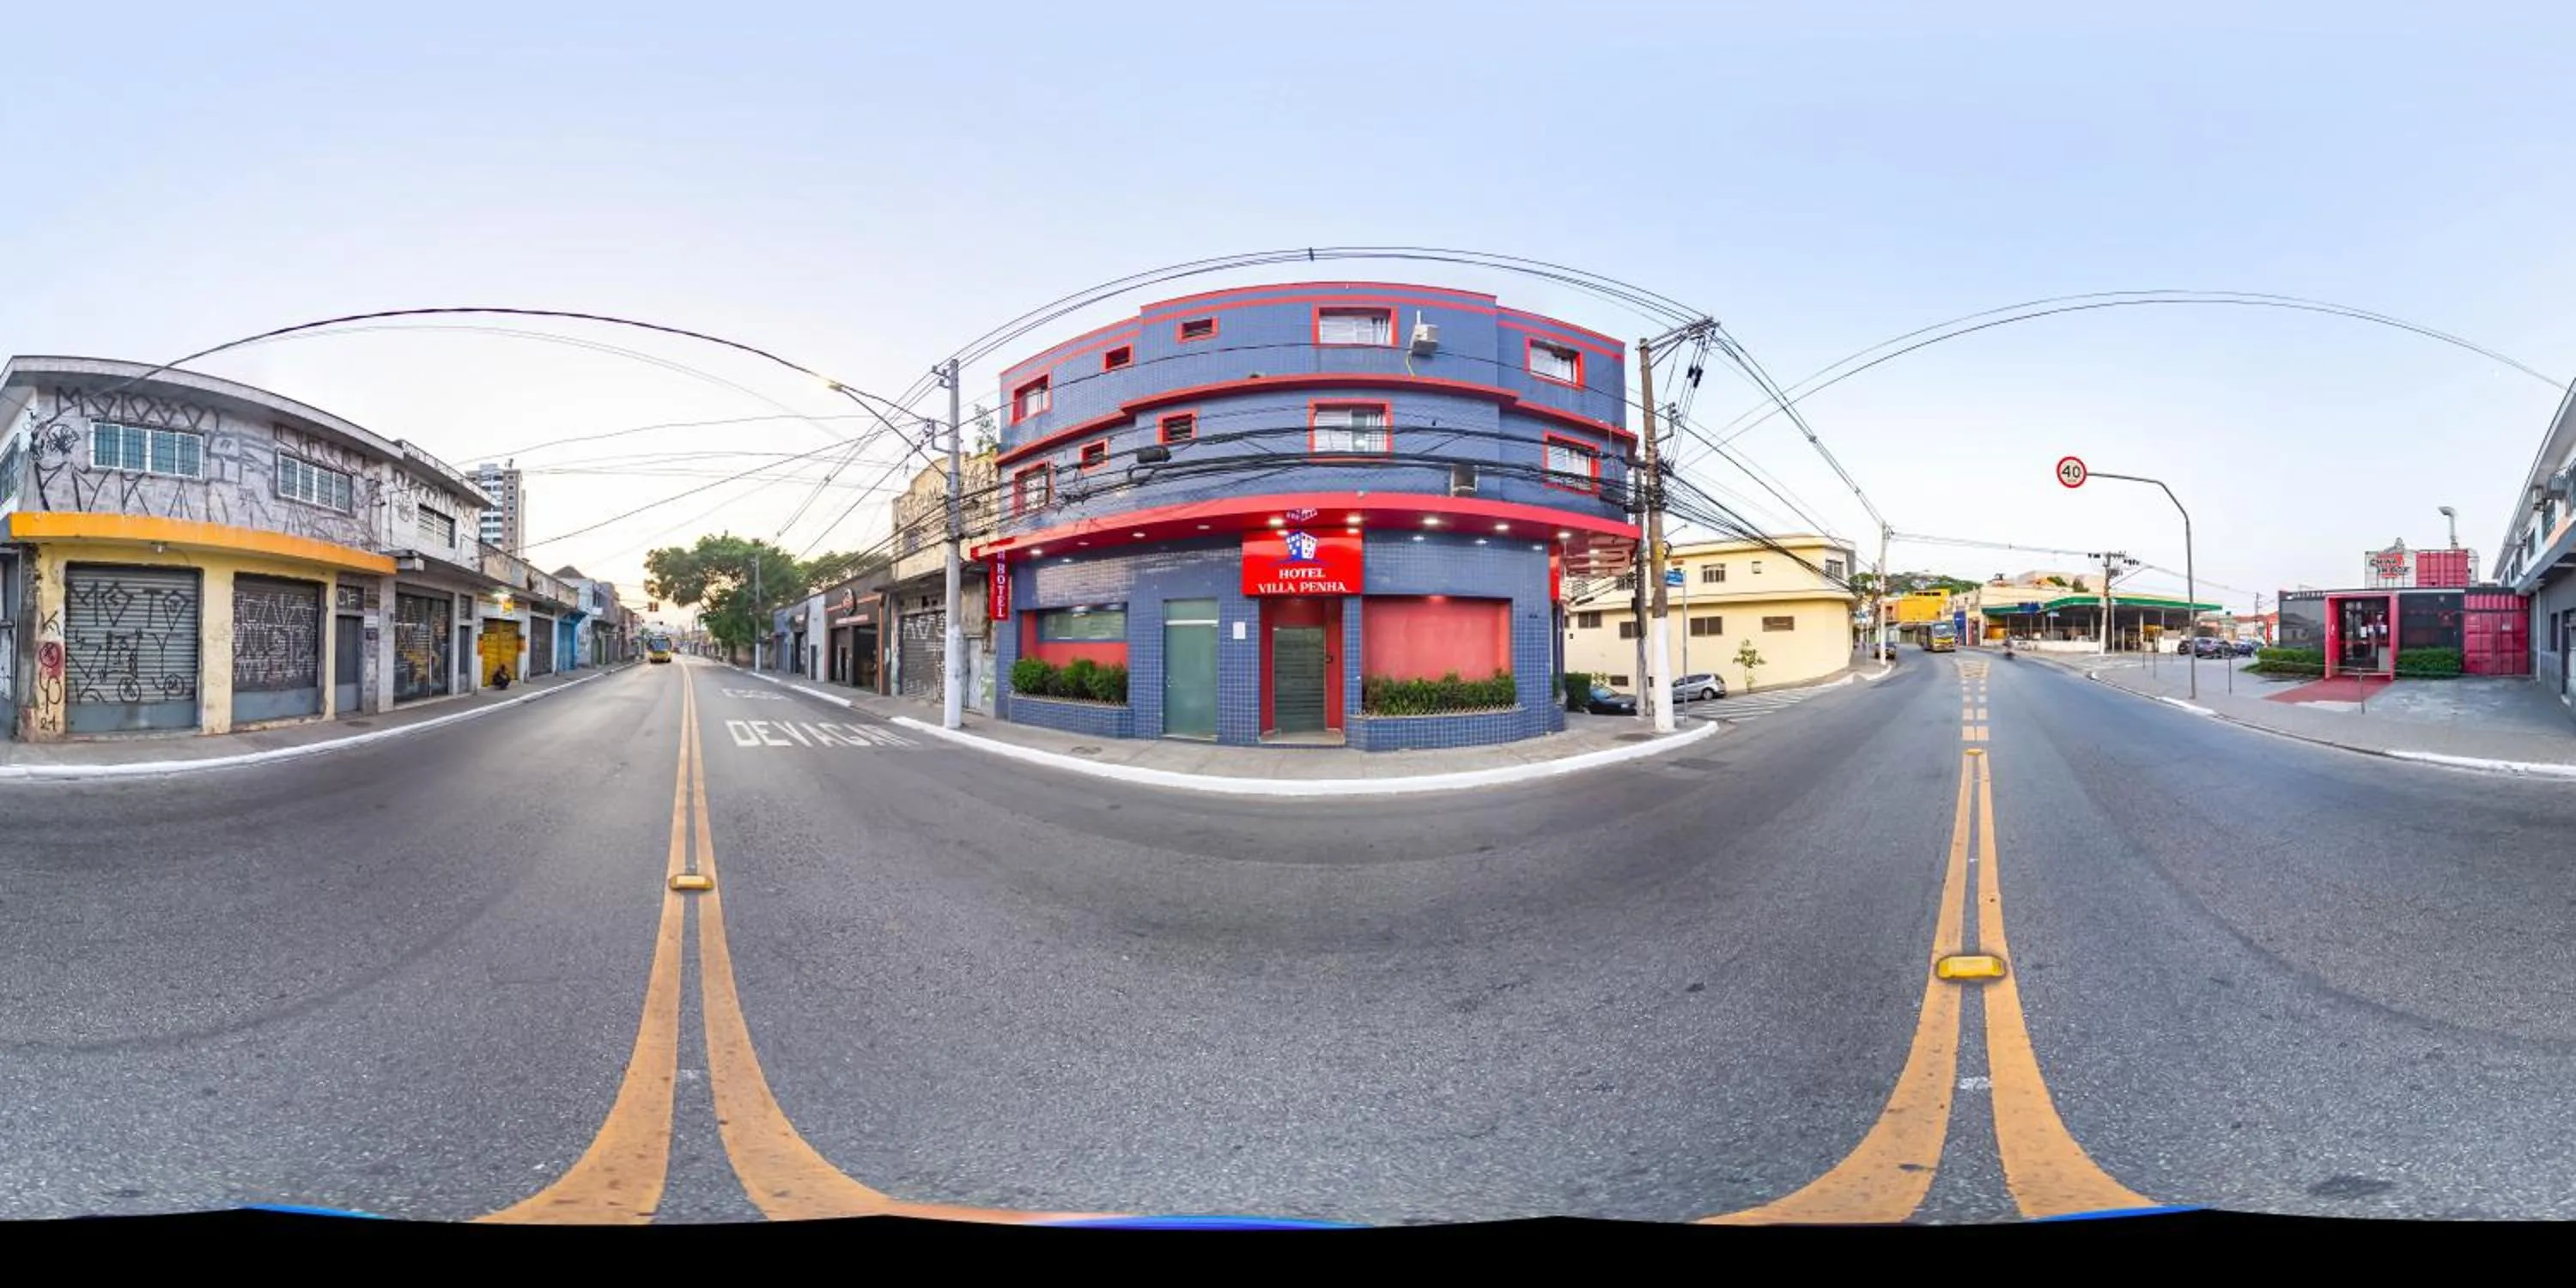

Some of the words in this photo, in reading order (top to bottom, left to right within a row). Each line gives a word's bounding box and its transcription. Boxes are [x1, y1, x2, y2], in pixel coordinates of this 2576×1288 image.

[2062, 465, 2081, 478] 40
[1279, 568, 1326, 579] HOTEL
[997, 562, 1005, 617] HOTEL
[1257, 582, 1296, 593] VILLA
[1299, 581, 1346, 592] PENHA
